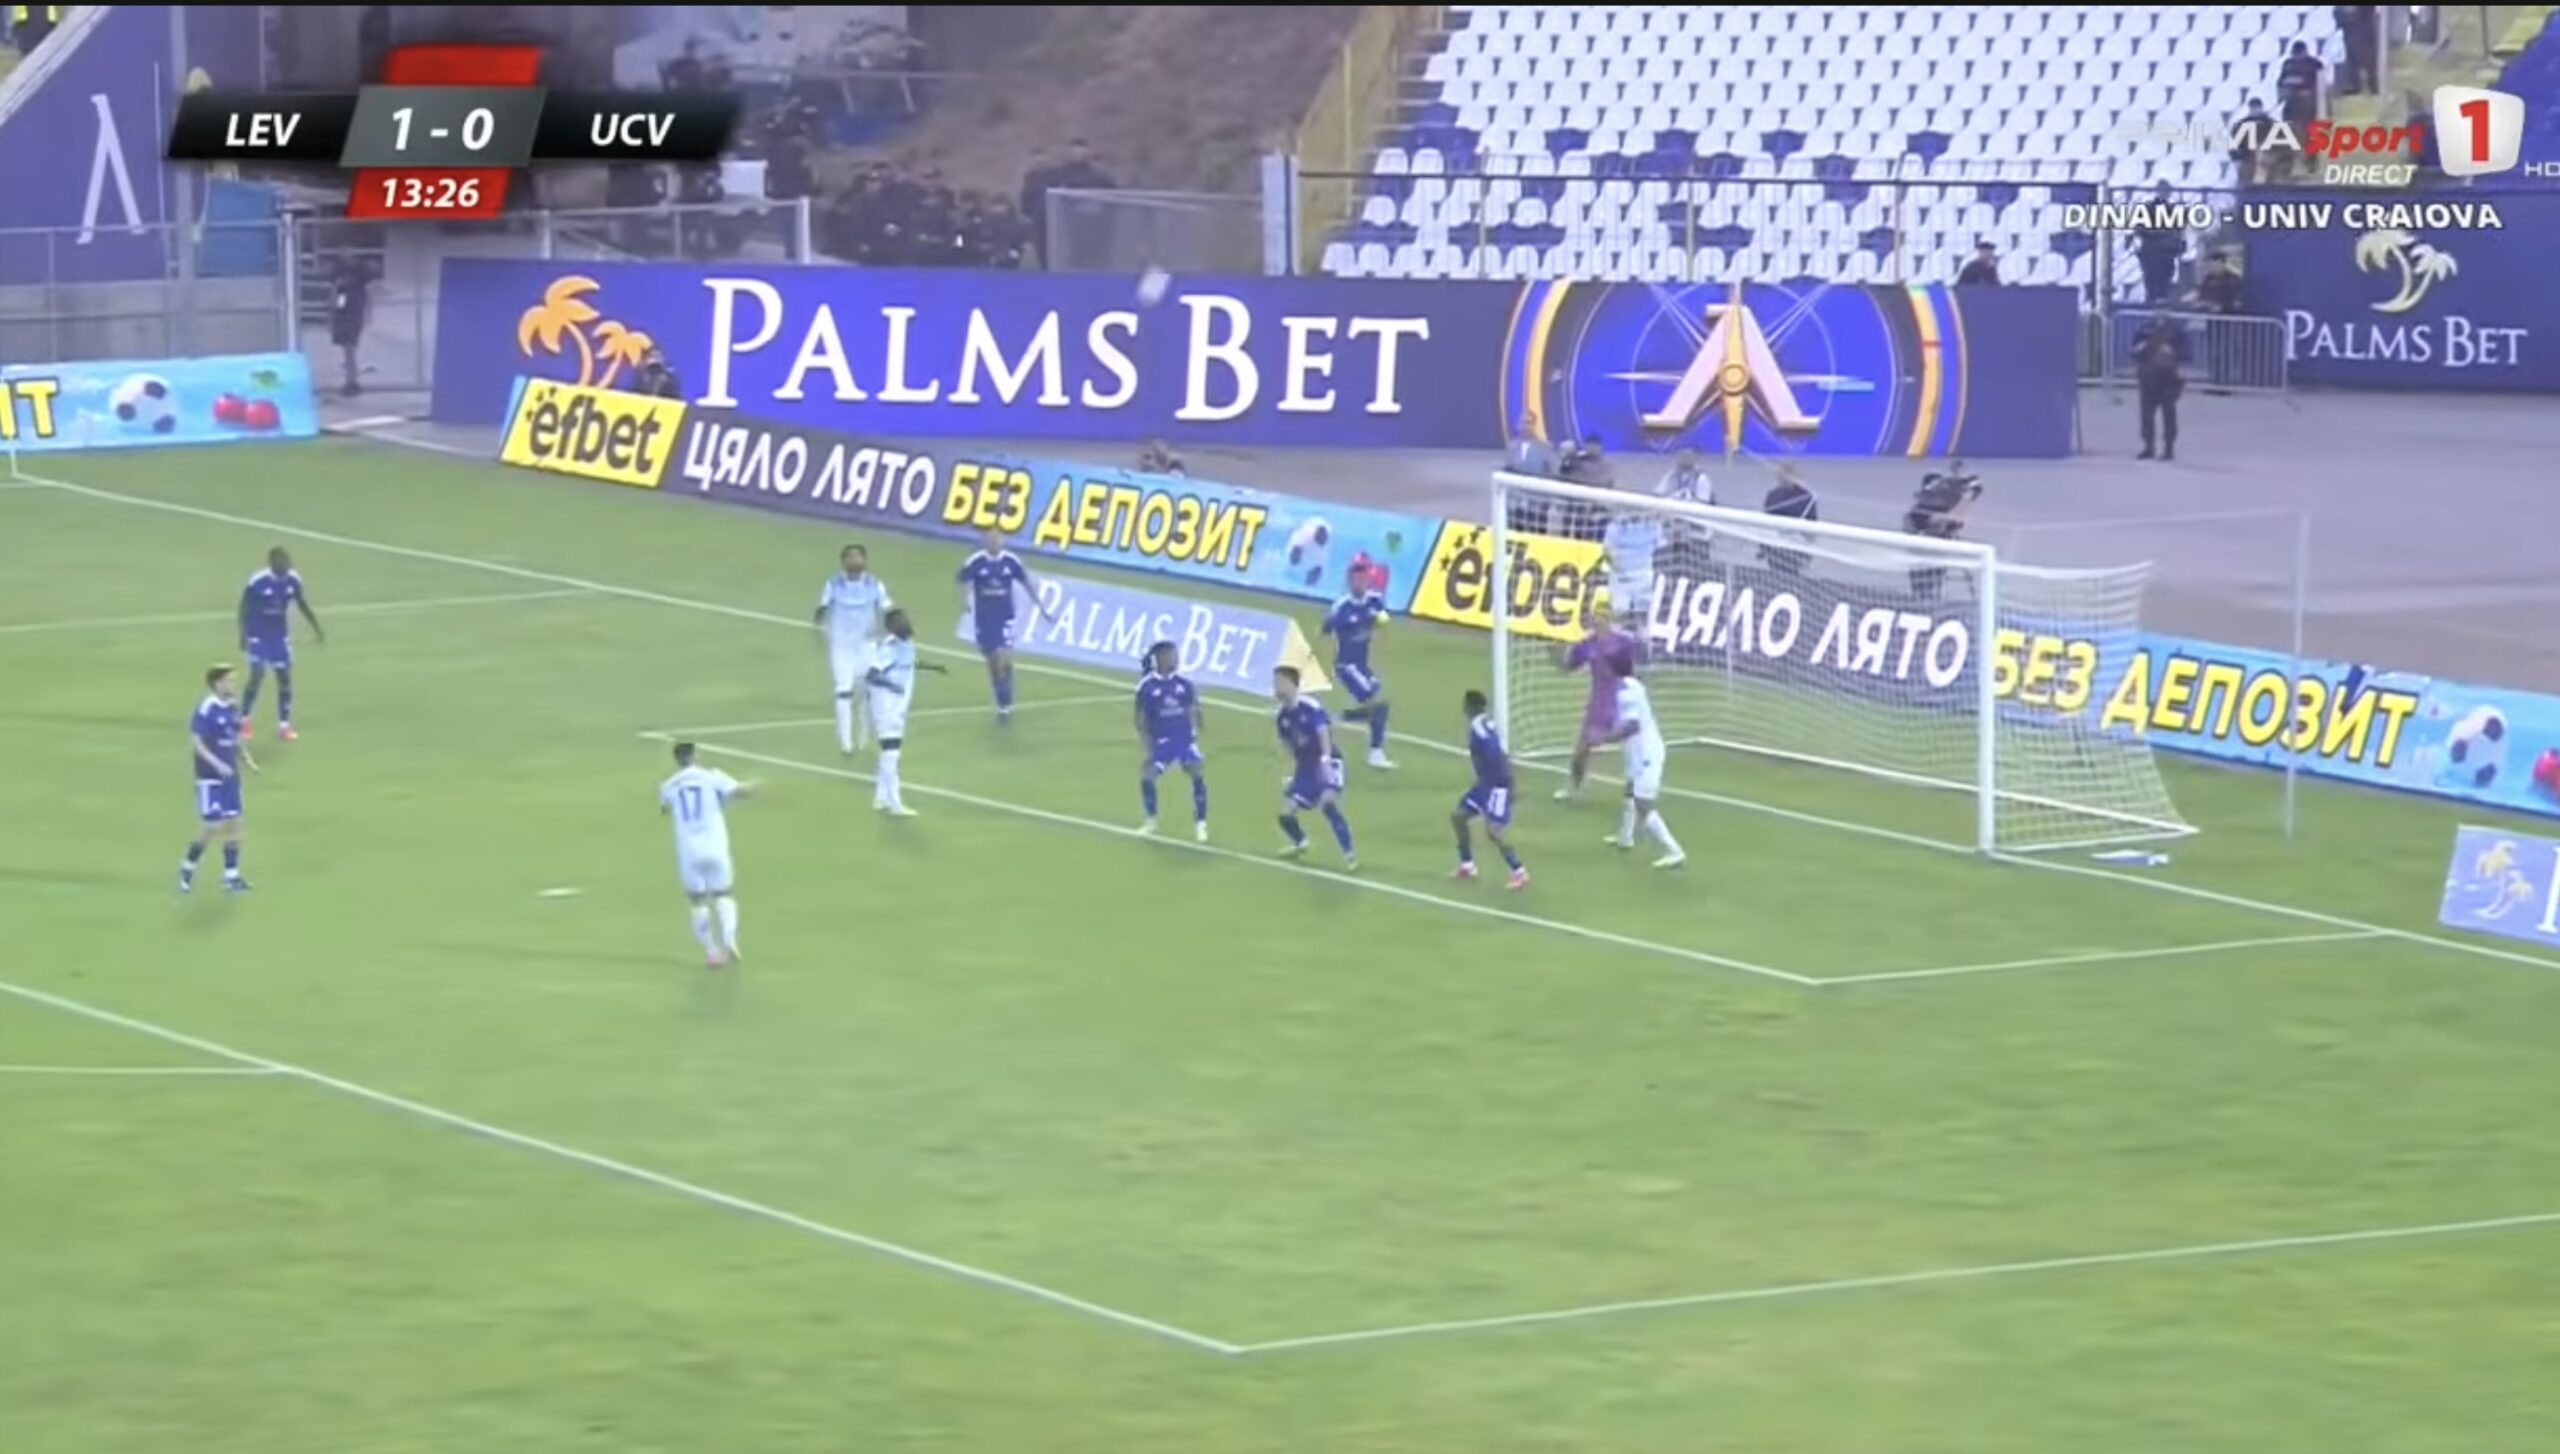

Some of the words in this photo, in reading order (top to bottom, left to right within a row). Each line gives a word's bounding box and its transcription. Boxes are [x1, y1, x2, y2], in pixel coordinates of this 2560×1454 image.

[696, 277, 1139, 409] PALMS
[1174, 293, 1431, 421] BET
[2285, 310, 2433, 363] PALMS
[2443, 315, 2529, 367] BET
[528, 393, 661, 475] efbet
[683, 421, 808, 494] ЦЯЛО
[811, 443, 937, 516] ЛЯТО
[941, 460, 1034, 534] БЕЗ
[1032, 474, 1270, 570] ДЕПОЗИТ
[1178, 603, 1269, 680] BET
[1648, 573, 1801, 659] ЦЯЛО
[1809, 601, 1970, 688] ЛЯТО
[1991, 627, 2097, 715] БЕЗ
[2100, 648, 2421, 768] ДЕПОЗИТ
[678, 785, 703, 822] 17
